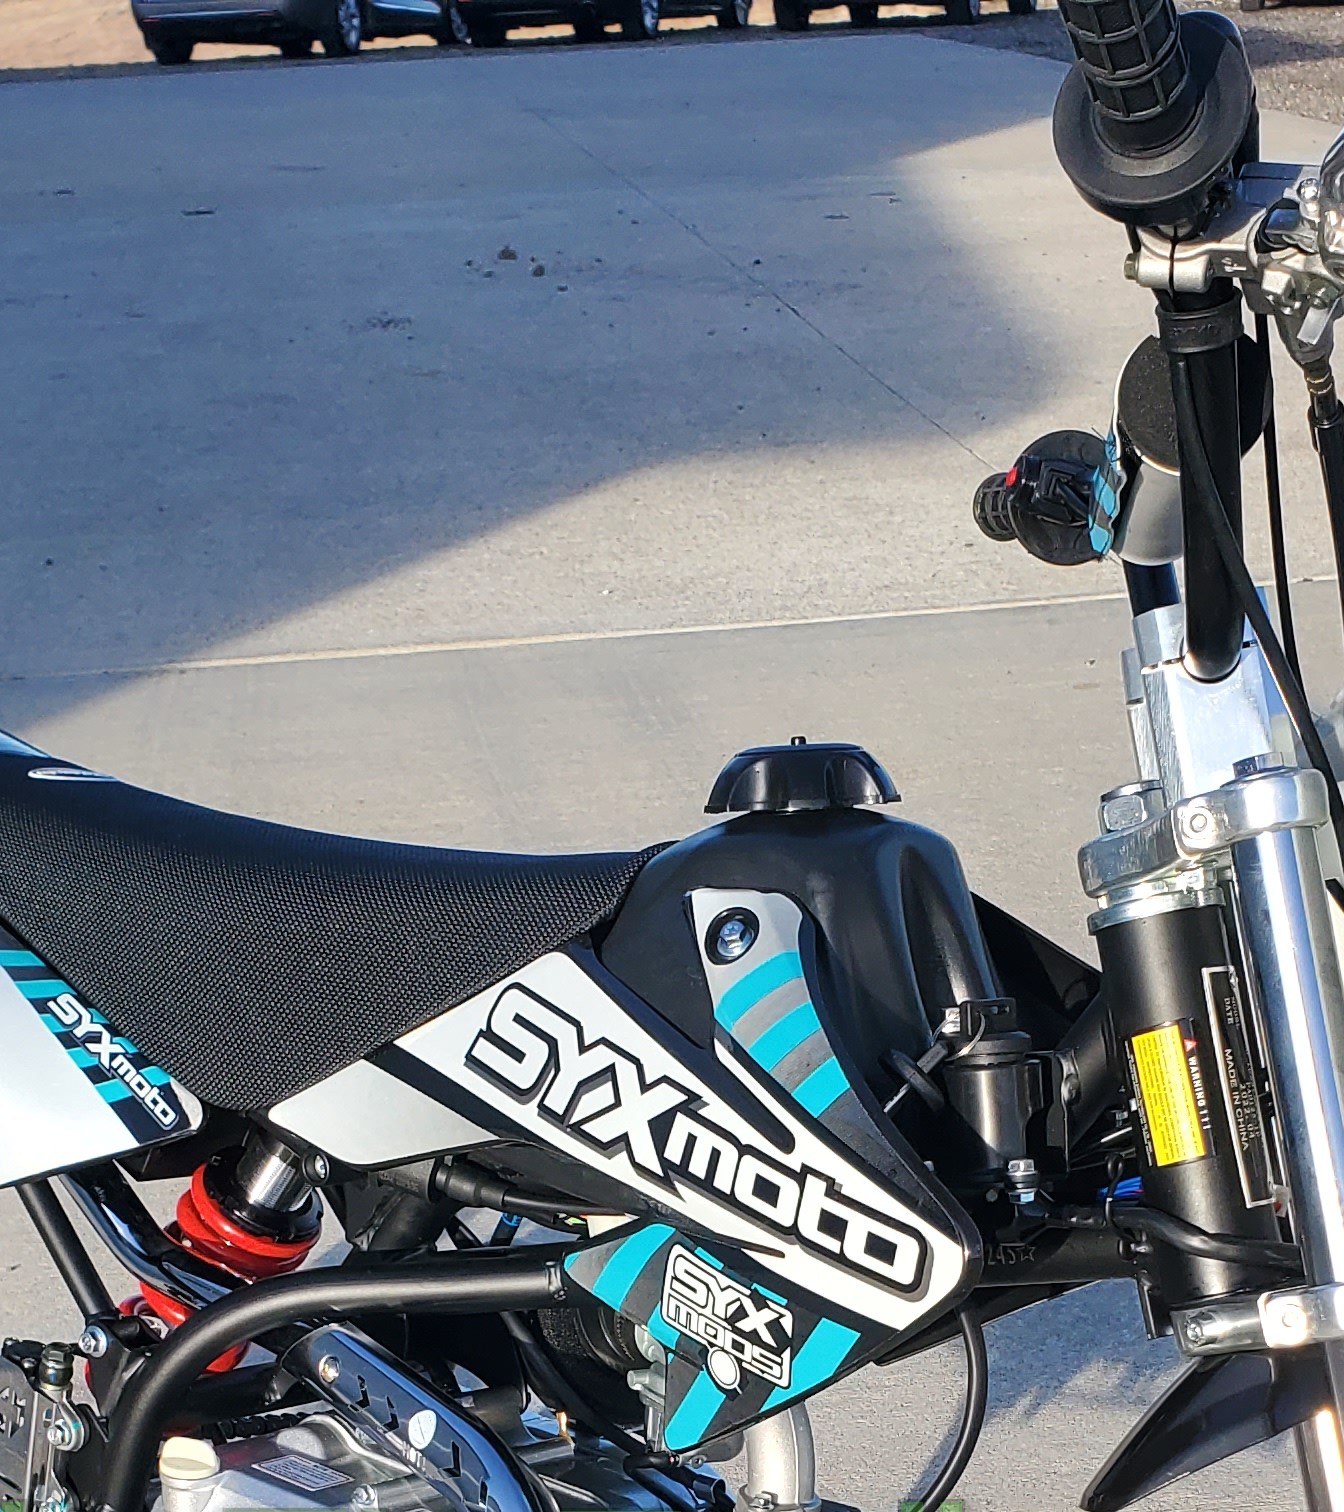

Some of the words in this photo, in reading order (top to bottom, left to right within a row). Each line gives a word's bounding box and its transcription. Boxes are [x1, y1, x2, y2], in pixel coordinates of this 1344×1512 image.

[1188, 1056, 1206, 1107] WARNING
[1224, 1048, 1236, 1088] MADE
[1233, 1091, 1239, 1105] IN
[1236, 1108, 1249, 1151] CHINA
